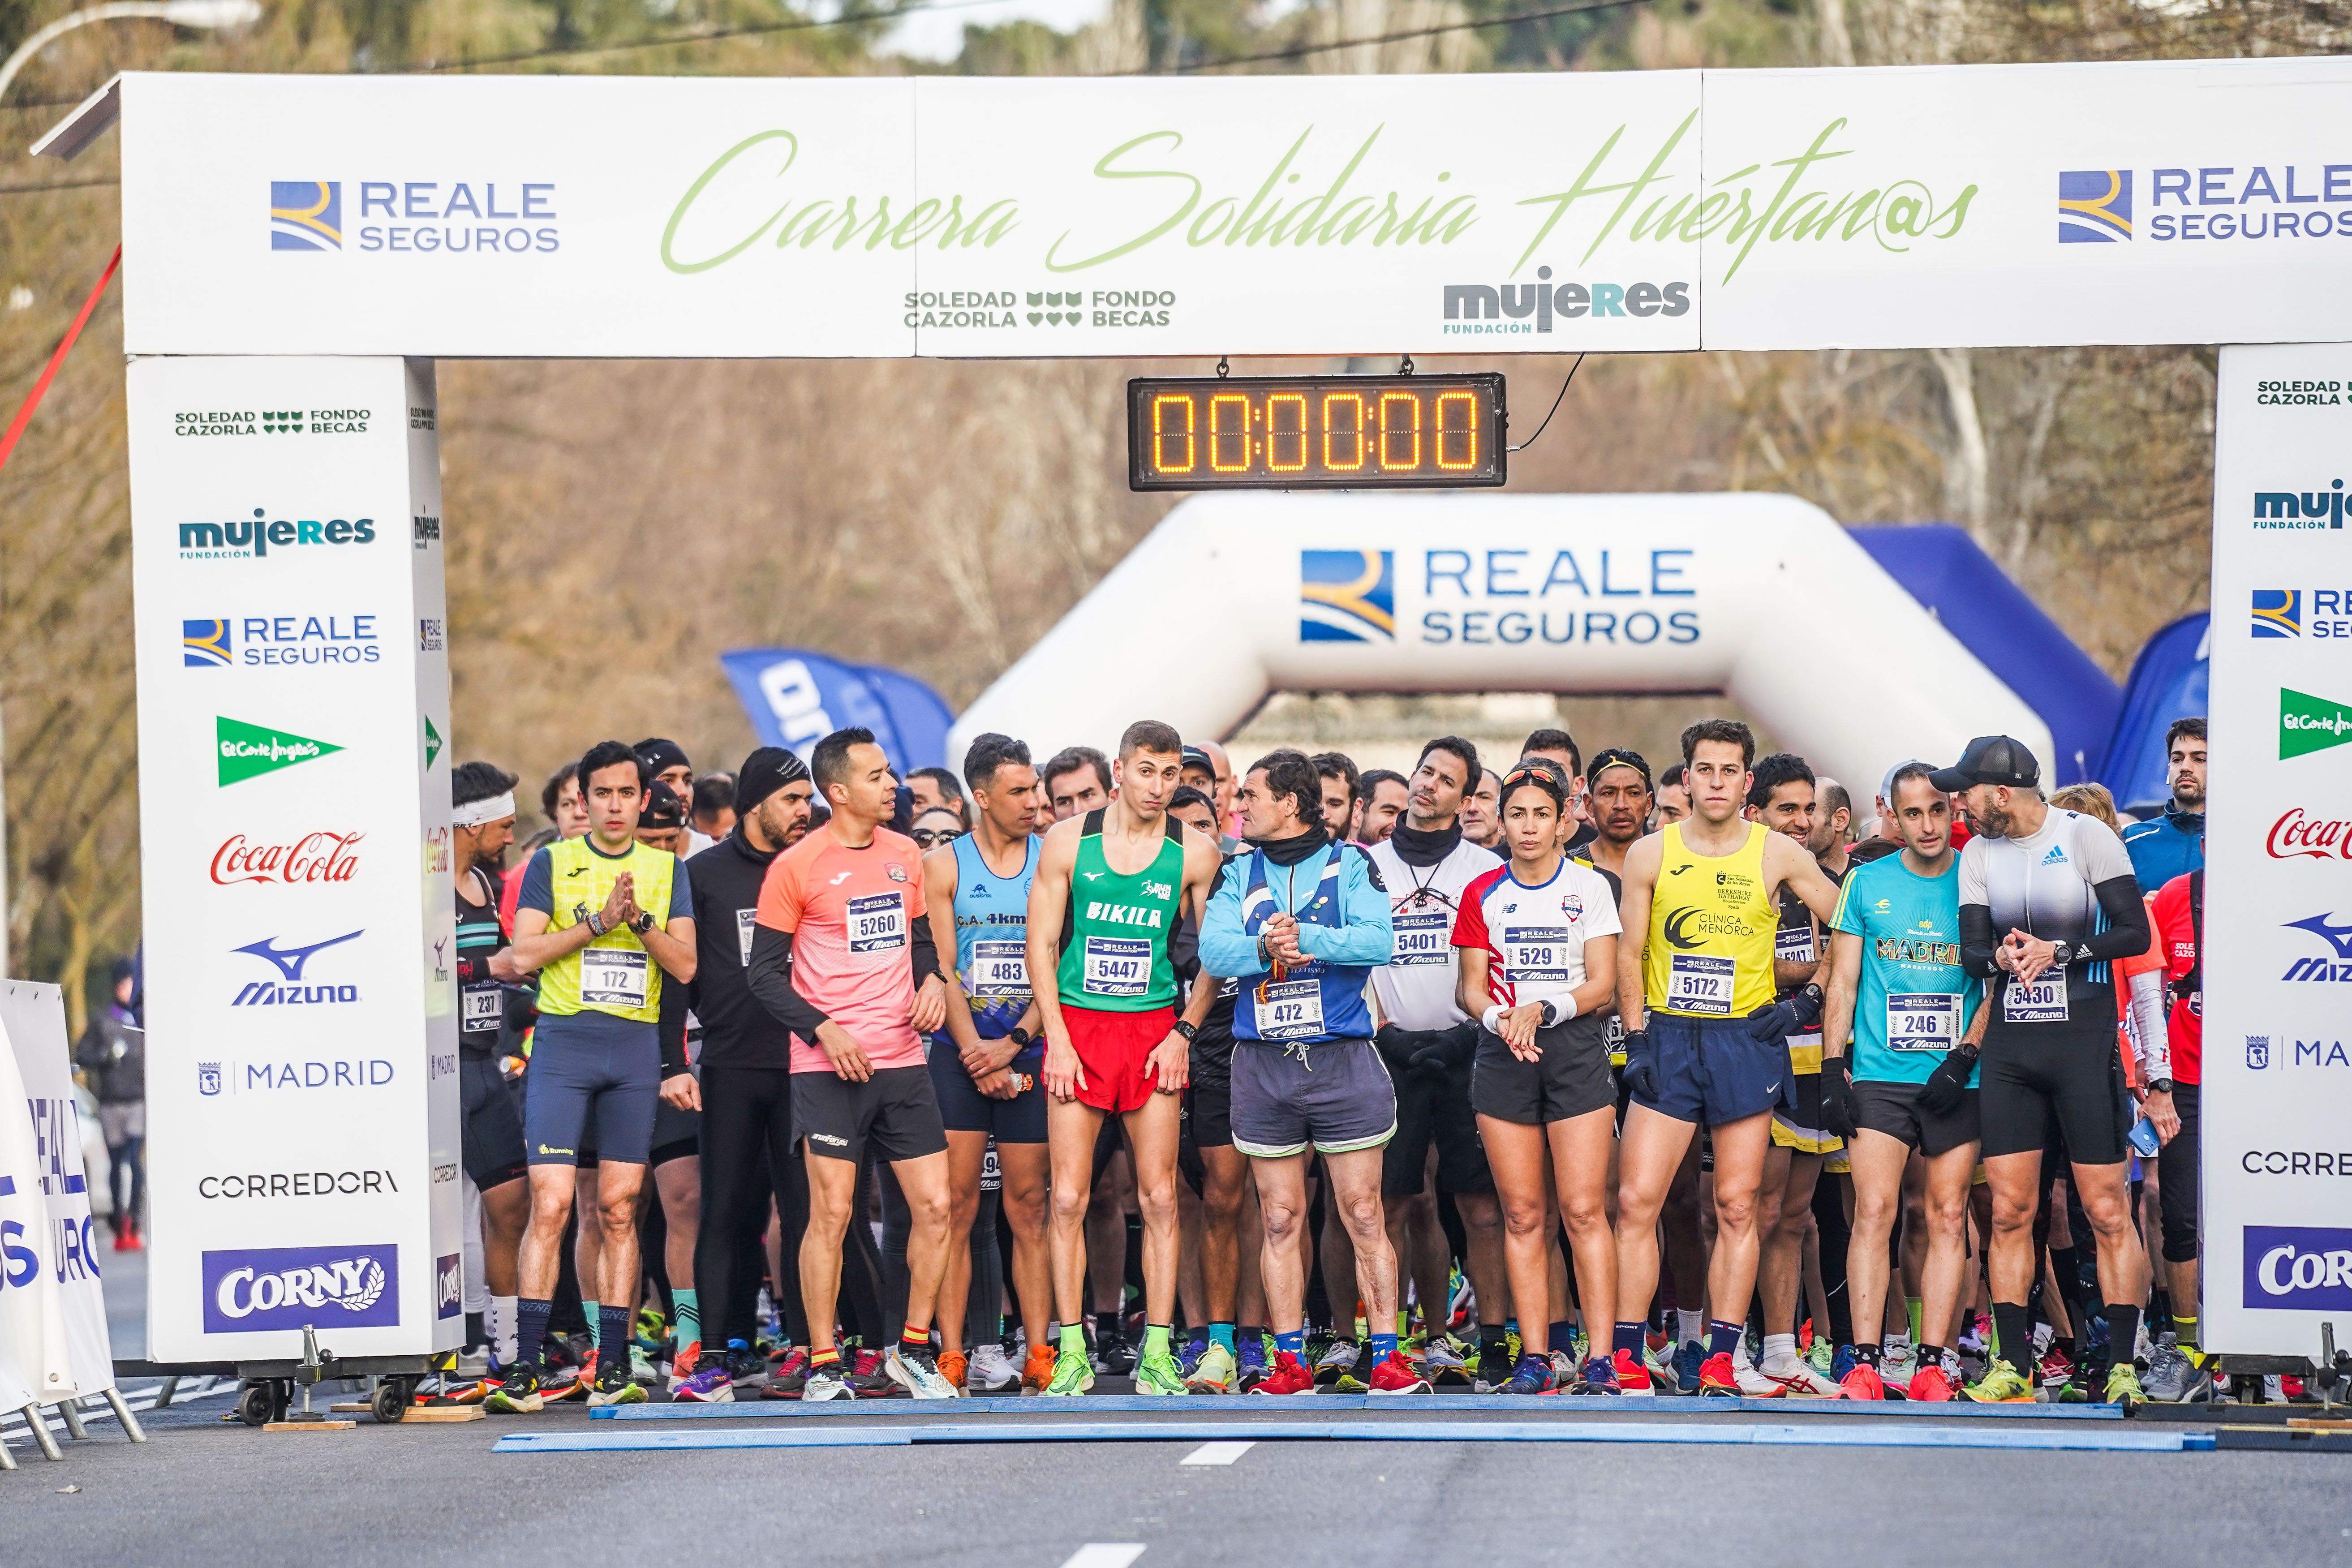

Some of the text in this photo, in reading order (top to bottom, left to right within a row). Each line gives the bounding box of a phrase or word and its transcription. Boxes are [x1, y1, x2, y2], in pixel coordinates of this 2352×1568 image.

[2152, 164, 2352, 207] REALE
[360, 182, 557, 219] REALE
[661, 107, 1979, 287] Carrera Solidaria Huérfan@s
[2150, 210, 2352, 241] SEGUROS
[359, 226, 561, 253] SEGUROS
[904, 290, 1177, 308] SOLEDAD FONDO
[904, 310, 1171, 328] CAZORLA BECAS
[1443, 321, 1532, 334] FUNDACIÓN
[2257, 381, 2341, 392] SOLEDAD
[2257, 394, 2341, 405] CAZORLA
[175, 409, 371, 424] SOLEDAD FONDO
[175, 422, 367, 436] CAZORLA BECAS
[1154, 392, 1477, 472] 00:00:00
[2253, 520, 2326, 529] FUNDACIÓN
[180, 549, 250, 559] FUNDACIÓN
[1425, 550, 1695, 597] REALE
[244, 615, 378, 643] REALE
[1422, 612, 1701, 644] SEGUROS
[244, 646, 380, 666] SEGUROS
[2299, 714, 2334, 730] Corte
[221, 737, 319, 762] El Corte Inglés
[210, 832, 367, 885] Coca-Cola
[2042, 857, 2068, 866] adidas
[957, 915, 983, 926] C.A.
[1086, 902, 1161, 928] BIKILA
[1699, 913, 1741, 925] CLÍNICA
[860, 915, 896, 936] 5260
[1698, 924, 1754, 936] MENORCA
[1398, 934, 1436, 951] 5401
[1520, 948, 1552, 965] 529
[991, 963, 1022, 980] 483
[1099, 960, 1139, 978] 5447
[1901, 963, 1944, 971] MARATHON
[602, 971, 628, 988] 172
[1683, 977, 1719, 996] 5172
[478, 996, 494, 1013] 237
[2014, 986, 2053, 1005] 5430
[1275, 1003, 1303, 1022] 472
[1905, 1016, 1936, 1033] 246
[438, 1054, 456, 1075] MADRID
[248, 1060, 395, 1089] MADRID
[216, 1257, 372, 1319] CORNY
